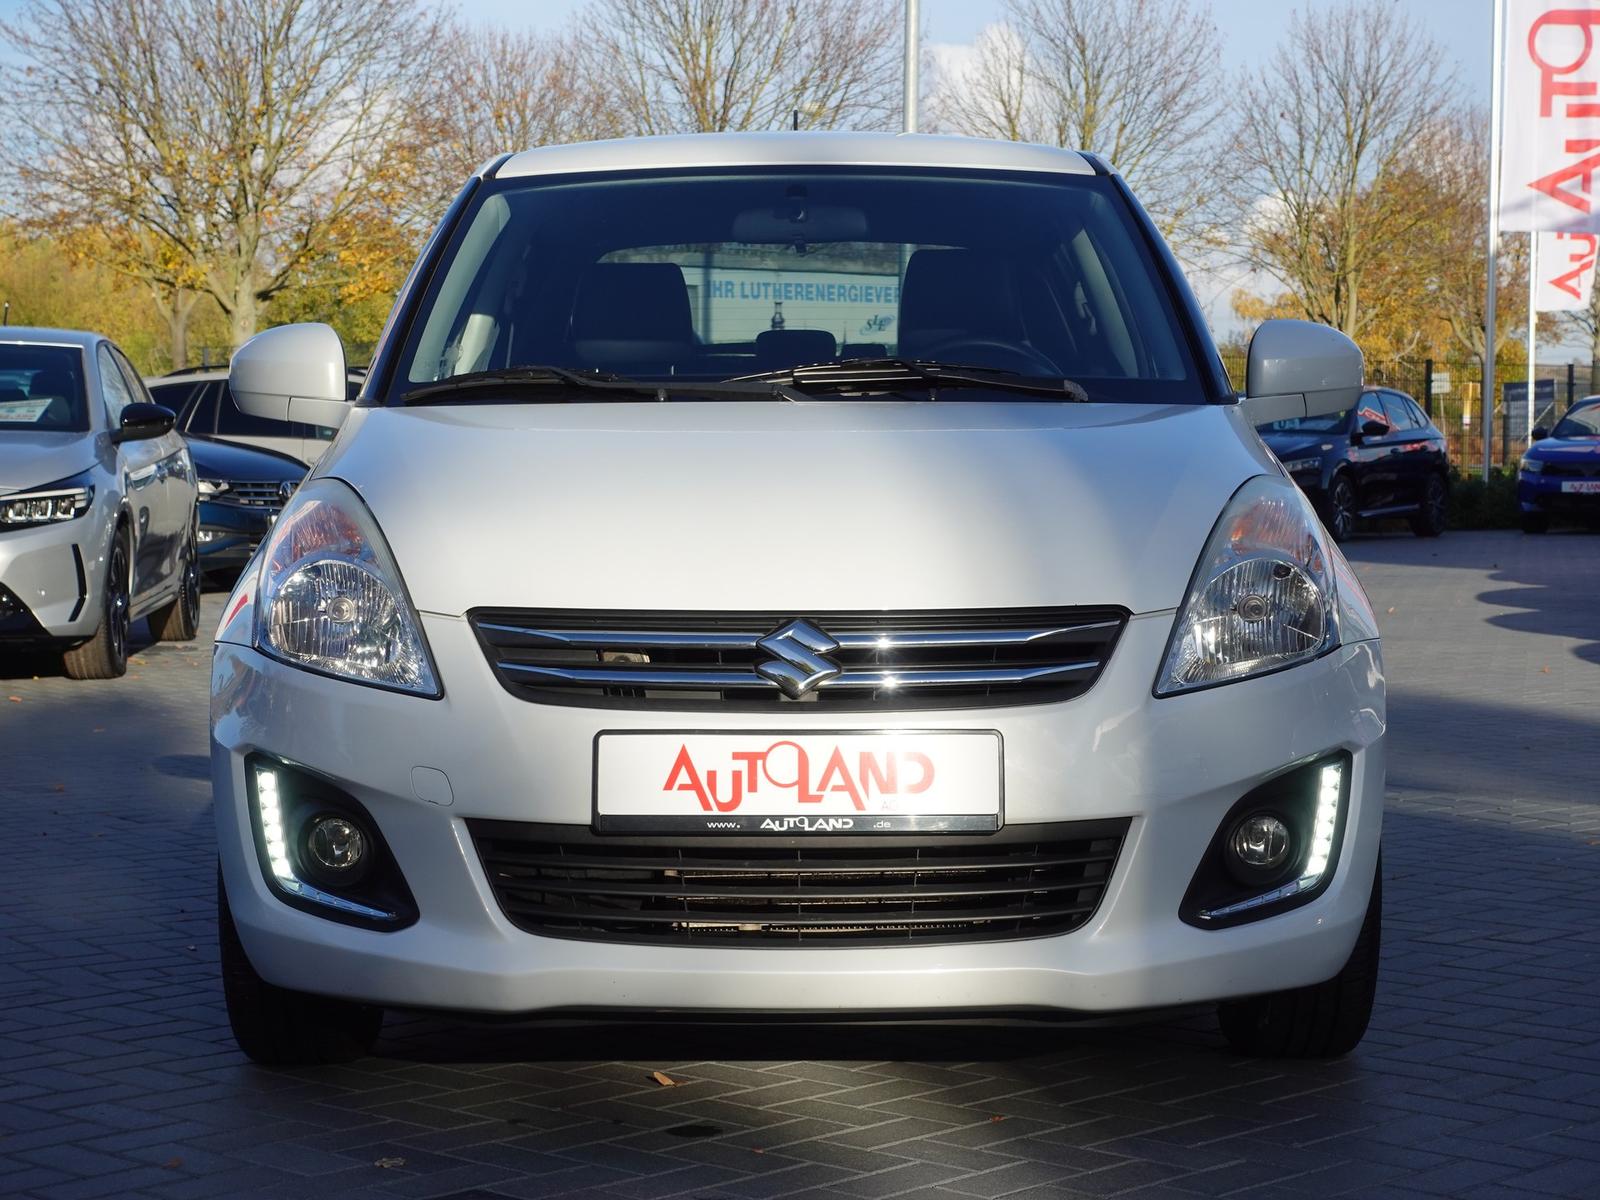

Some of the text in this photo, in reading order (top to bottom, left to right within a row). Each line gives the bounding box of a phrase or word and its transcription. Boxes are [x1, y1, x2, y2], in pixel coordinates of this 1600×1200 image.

[663, 740, 935, 812] AUTOLAND
[706, 816, 891, 831] www. AUTOLAND .de
